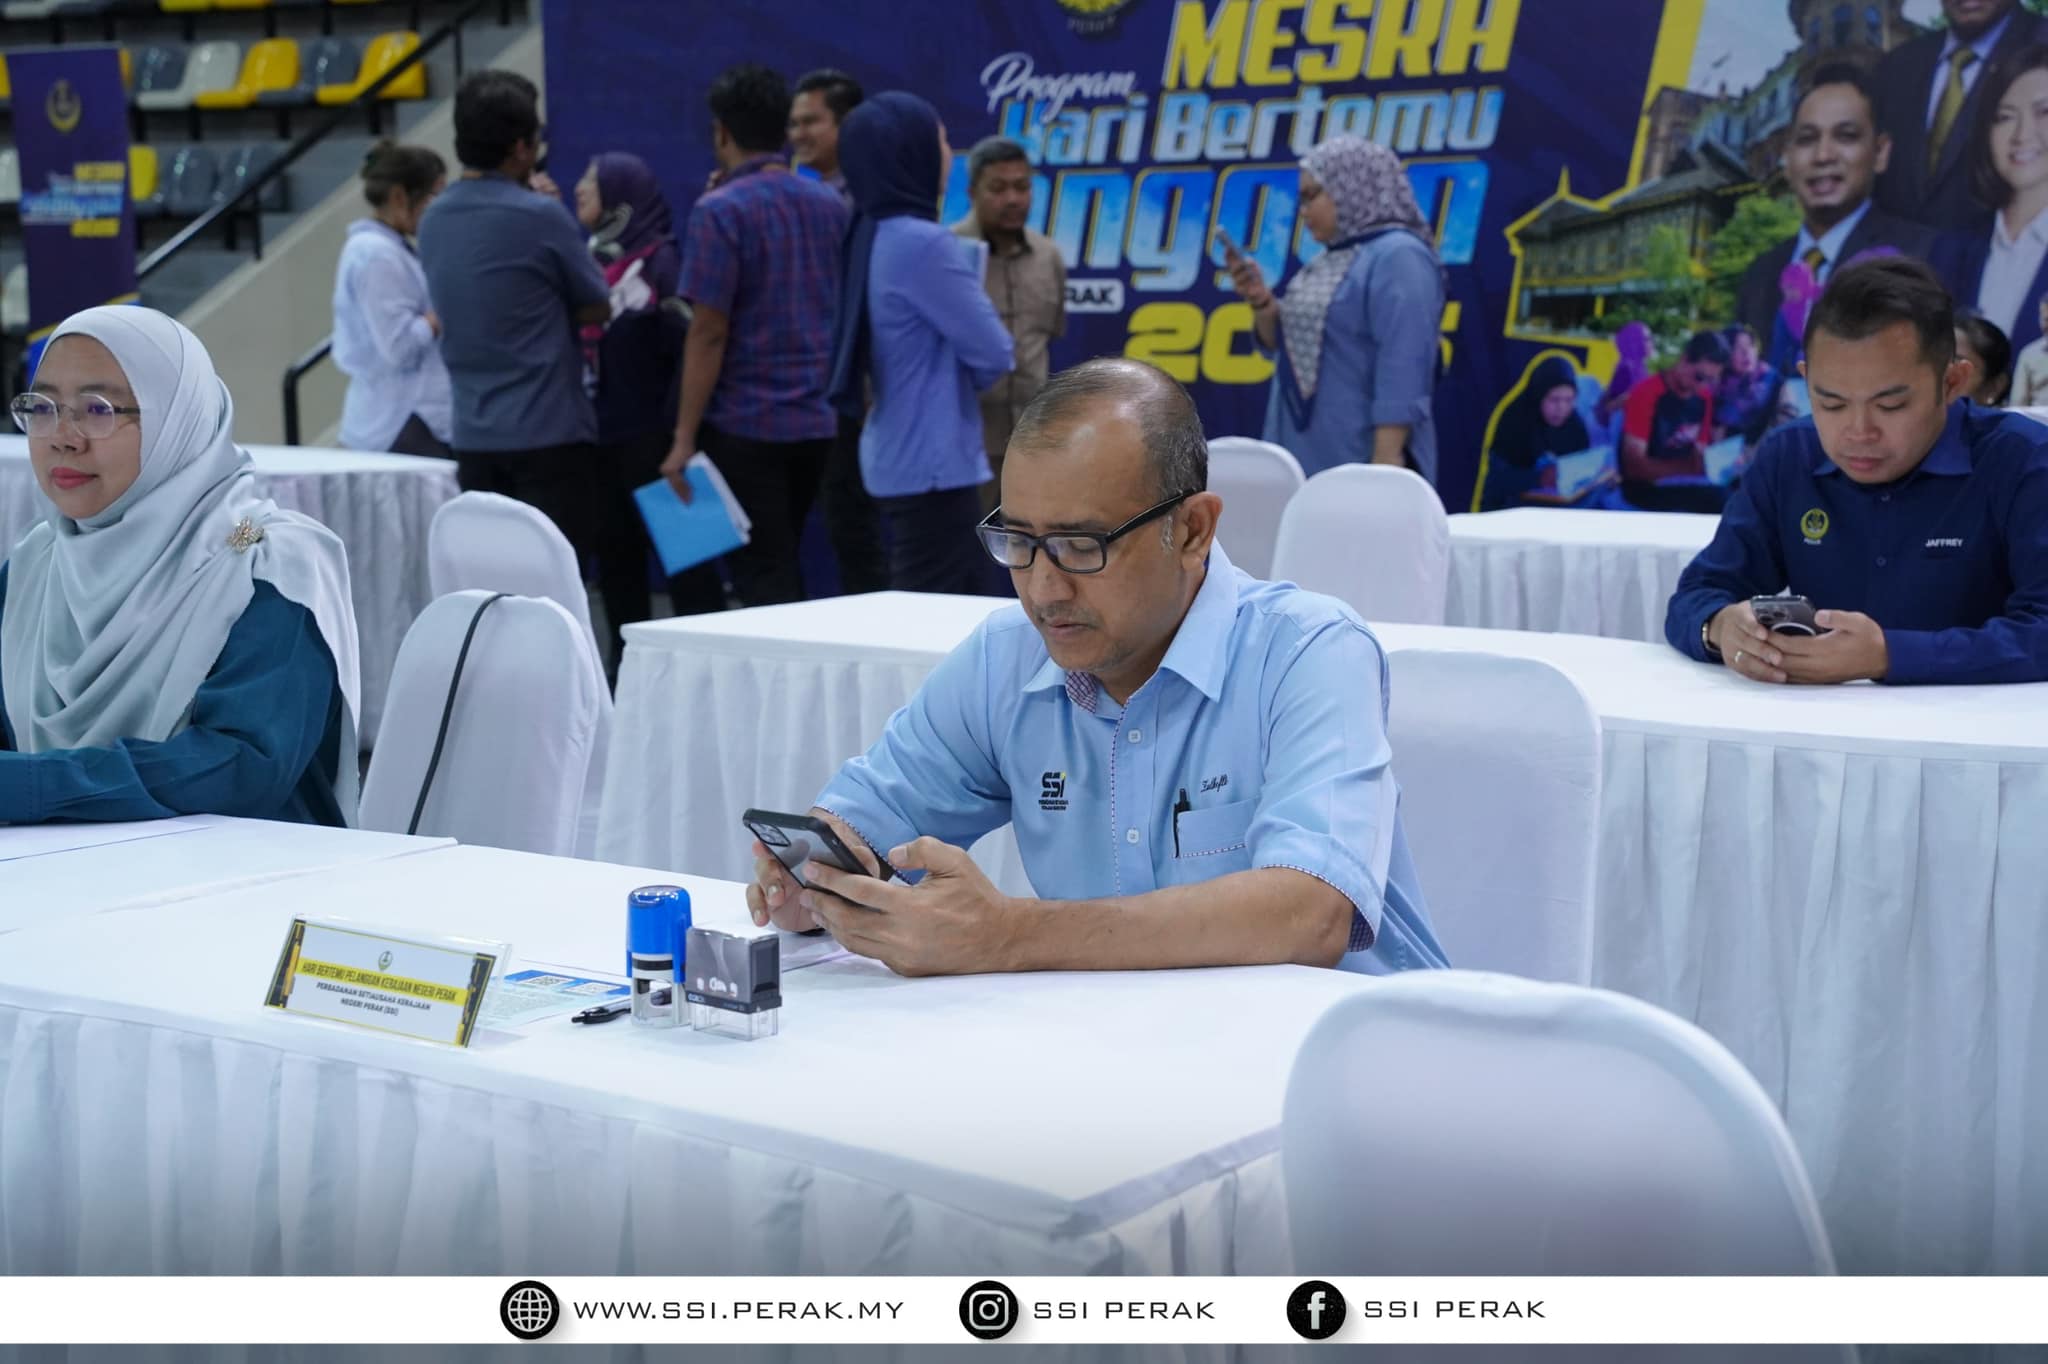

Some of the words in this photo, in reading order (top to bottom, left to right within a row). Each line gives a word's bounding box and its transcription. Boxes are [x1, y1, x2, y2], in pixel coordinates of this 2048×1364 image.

[979, 52, 1136, 124] Program
[1000, 92, 1148, 165] Hari
[1152, 84, 1504, 162] Bertemu
[1925, 538, 1963, 547] JAFFREY
[302, 962, 317, 974] HARI
[317, 964, 344, 980] BERTEMU
[344, 969, 381, 987] PELANGGAN
[380, 976, 412, 993] KERAJAAN
[412, 982, 436, 996] NEGERI
[435, 986, 456, 1001] PERAK
